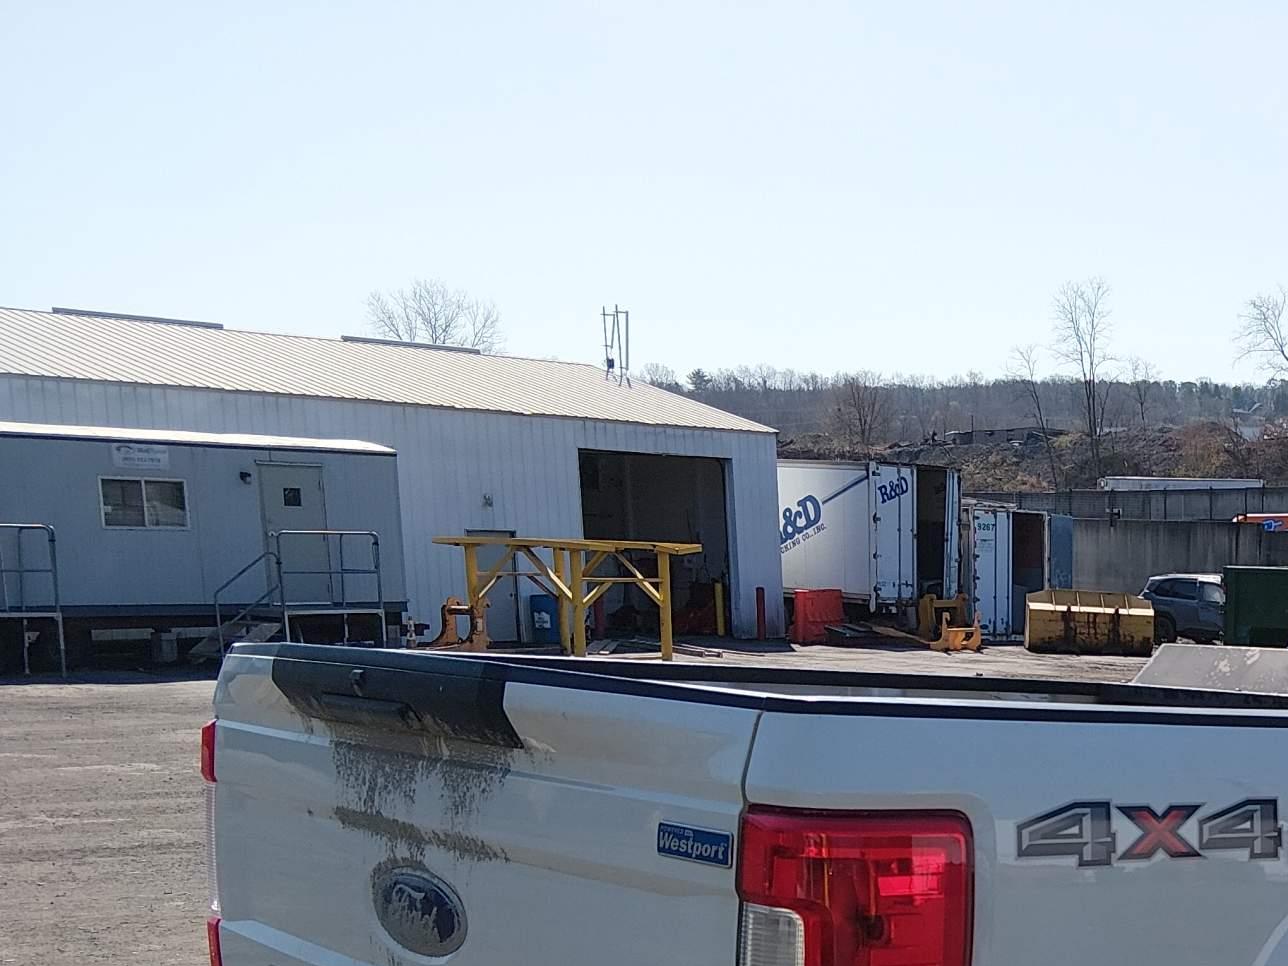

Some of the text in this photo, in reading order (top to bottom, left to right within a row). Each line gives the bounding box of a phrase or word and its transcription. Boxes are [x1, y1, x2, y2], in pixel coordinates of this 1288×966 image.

[878, 476, 908, 504] R&D
[779, 494, 821, 545] &D
[977, 522, 995, 531] 9267
[660, 831, 727, 860] Westport
